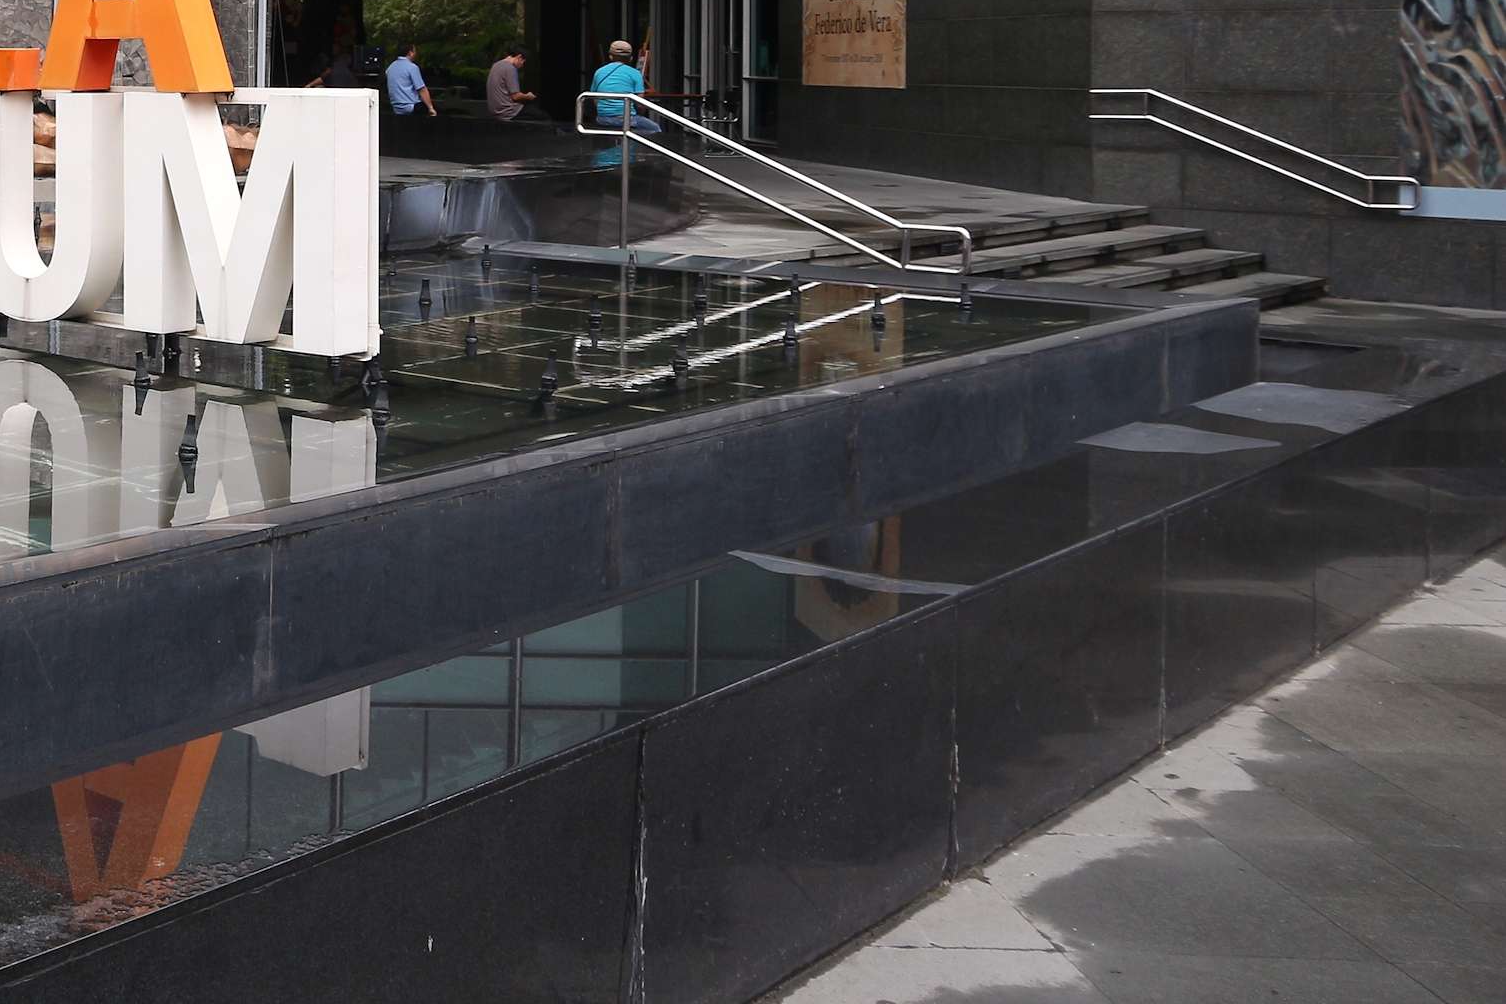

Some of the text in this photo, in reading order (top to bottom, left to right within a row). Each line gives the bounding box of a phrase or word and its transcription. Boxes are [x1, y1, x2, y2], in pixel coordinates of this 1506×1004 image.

[814, 5, 892, 35] Federico de Vera
